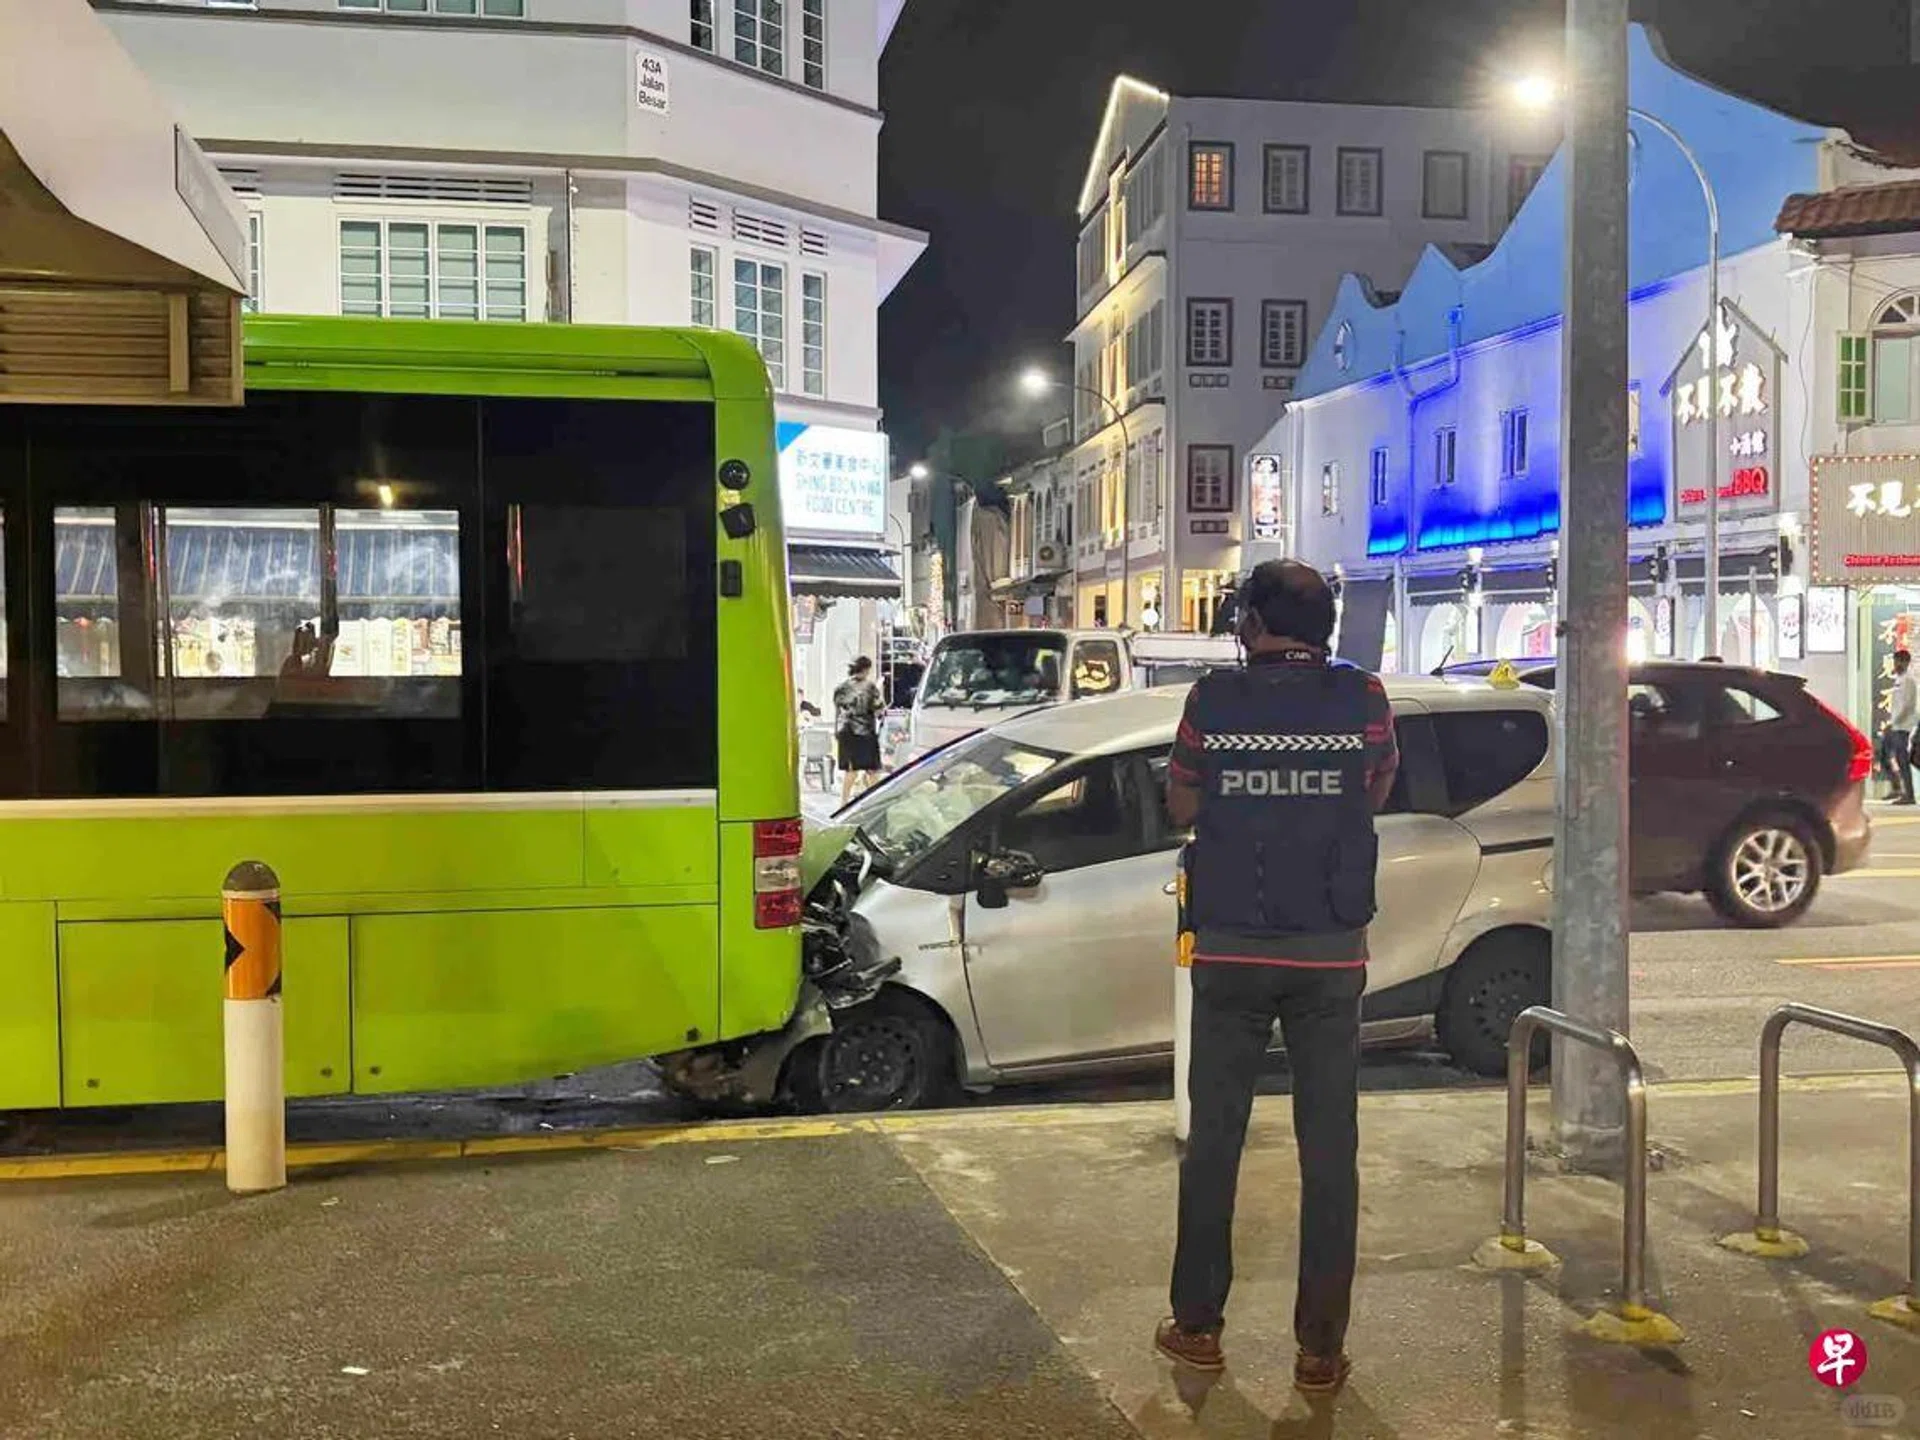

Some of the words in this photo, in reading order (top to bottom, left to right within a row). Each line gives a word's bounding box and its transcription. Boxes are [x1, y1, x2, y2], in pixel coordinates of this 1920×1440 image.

[642, 58, 661, 74] 43A
[640, 73, 665, 92] Jalan
[639, 91, 666, 109] Besar
[1732, 467, 1767, 495] BBQ
[1220, 769, 1342, 796] POLICE
